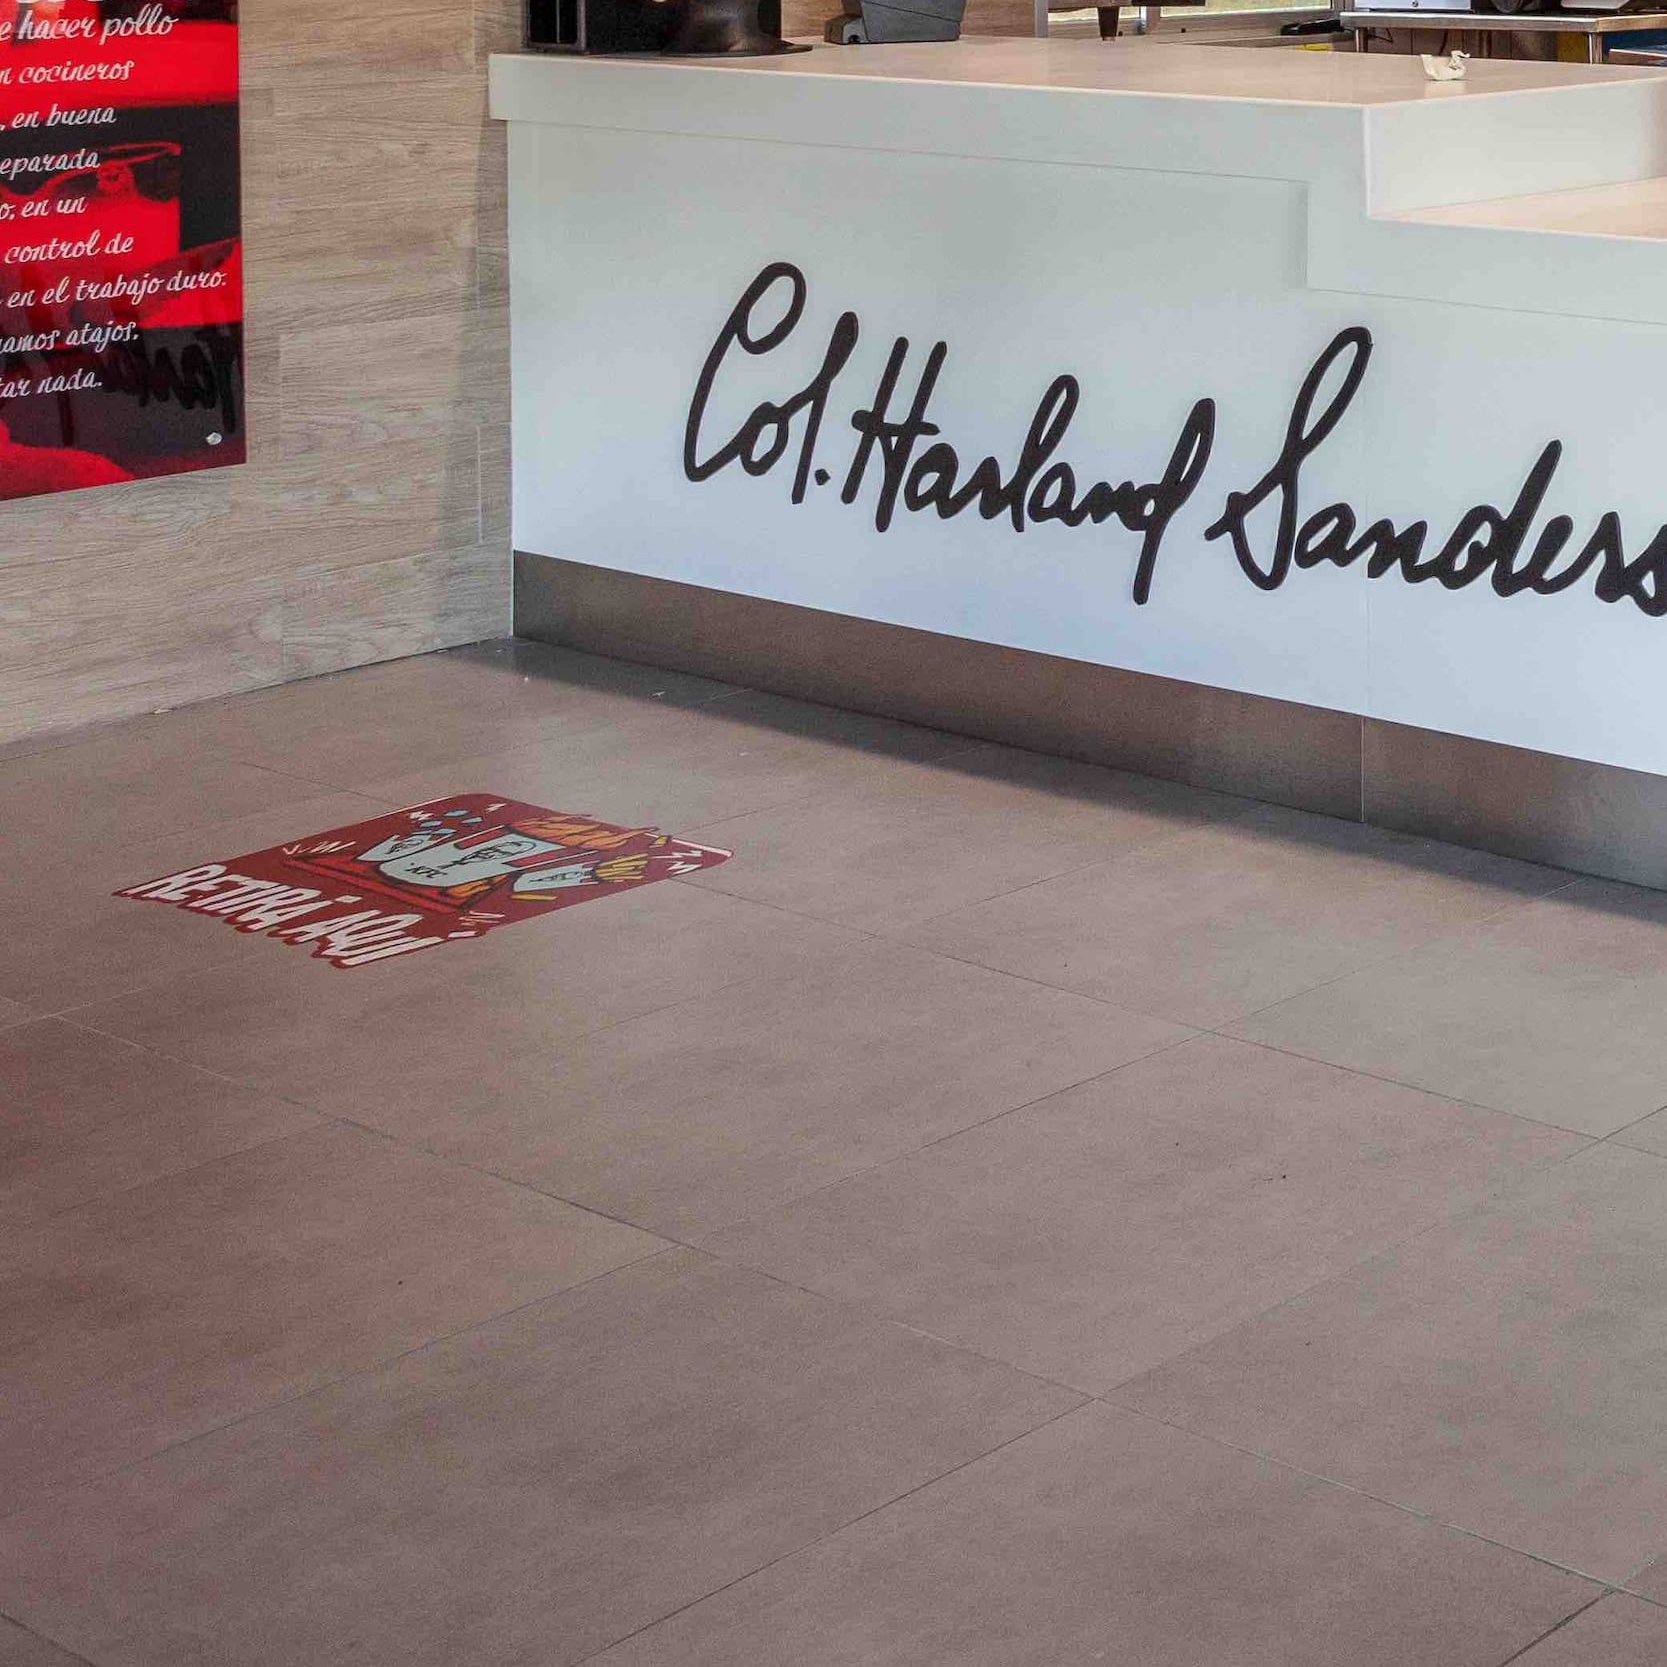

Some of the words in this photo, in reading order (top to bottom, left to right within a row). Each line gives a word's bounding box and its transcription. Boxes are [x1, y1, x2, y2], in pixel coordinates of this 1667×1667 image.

[18, 10, 98, 40] hacer
[101, 3, 179, 45] pollo
[20, 60, 135, 85] cocineros
[13, 110, 39, 129] en
[47, 102, 117, 127] buena
[22, 198, 49, 216] en
[56, 195, 87, 215] un
[5, 232, 100, 265] control
[105, 232, 134, 256] de
[8, 289, 34, 308] en
[42, 277, 70, 305] el
[76, 274, 164, 306] trabajo
[168, 270, 227, 293] duro.
[65, 320, 139, 353] atajos.
[38, 369, 103, 392] nada.
[684, 262, 858, 505] Col.
[842, 336, 1216, 605] Harland
